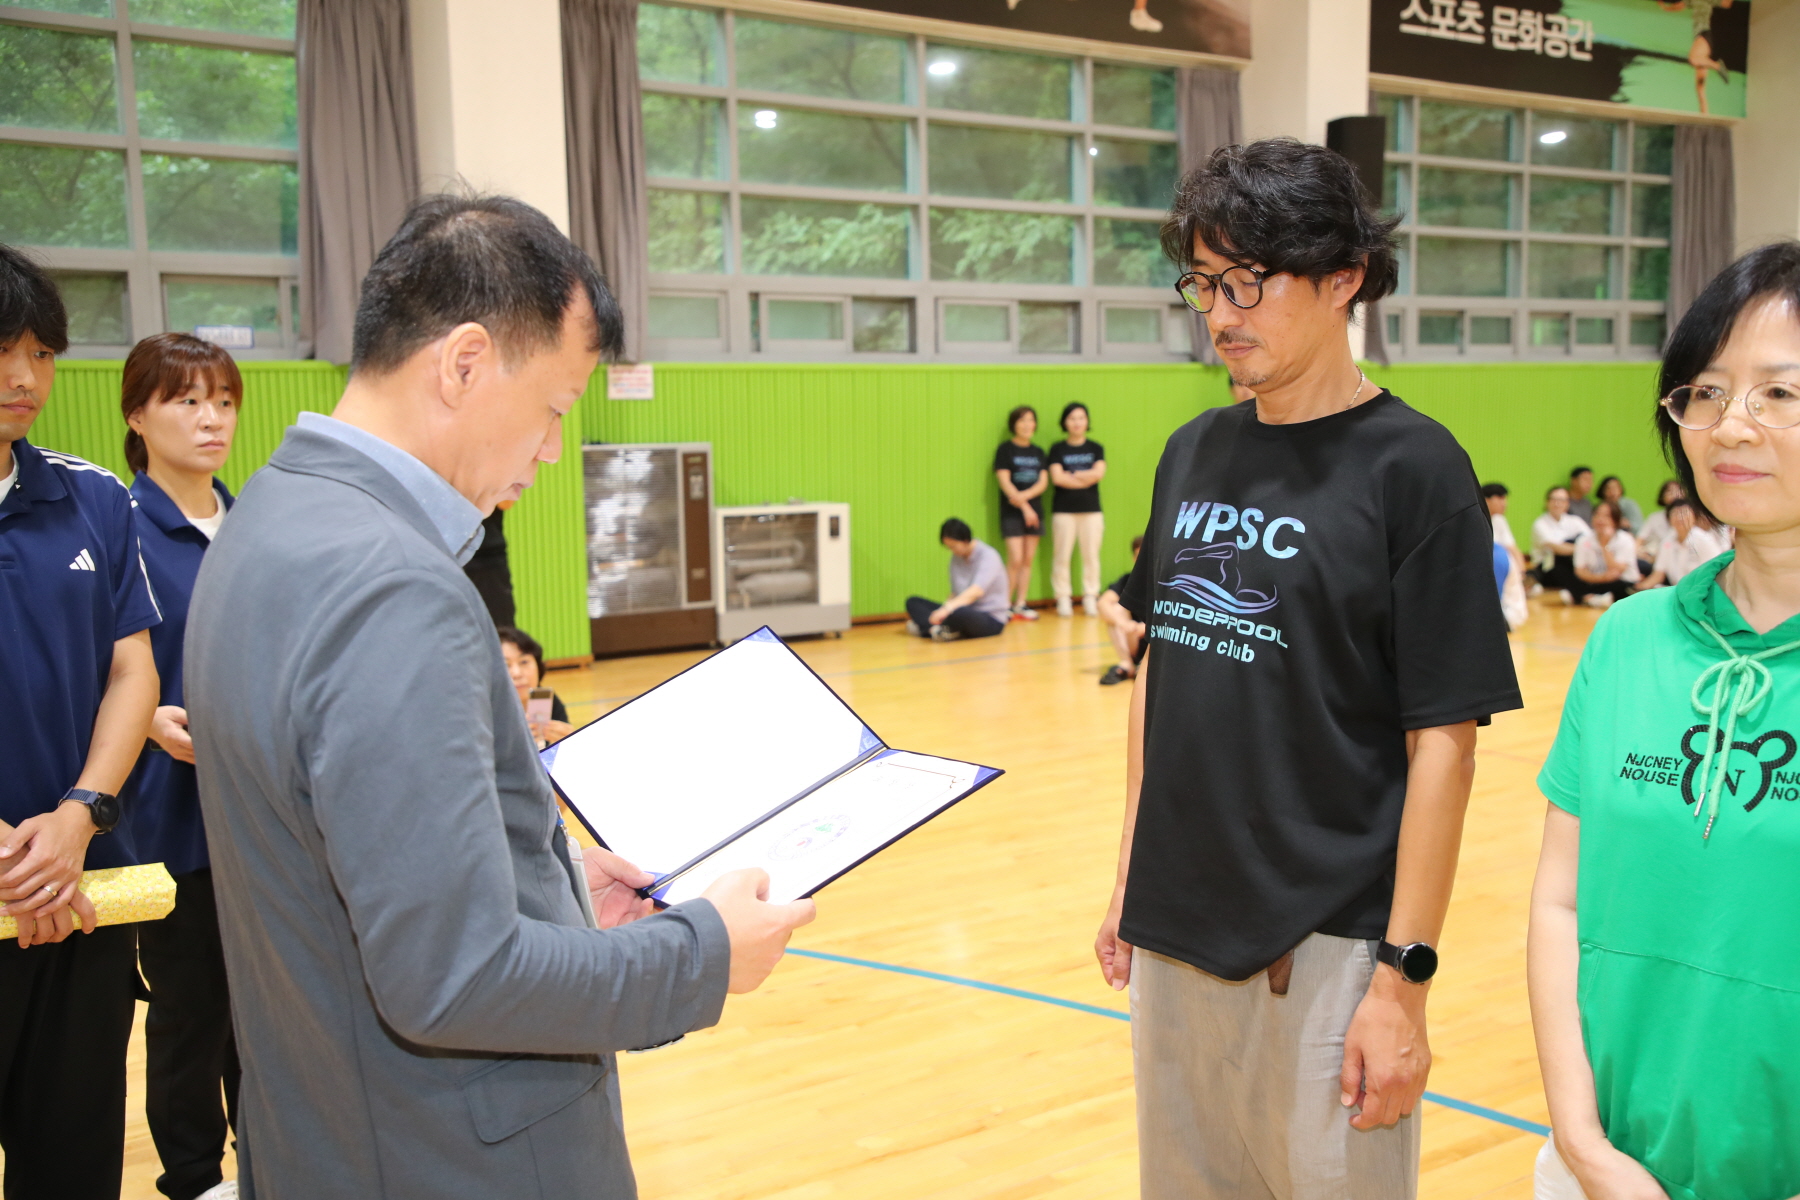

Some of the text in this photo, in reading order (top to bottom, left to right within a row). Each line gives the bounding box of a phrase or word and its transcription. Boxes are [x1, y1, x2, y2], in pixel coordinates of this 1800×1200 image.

[1399, 0, 1595, 62] 스포츠 문화공간
[1173, 501, 1306, 560] WPSC
[1216, 639, 1255, 663] club
[1625, 752, 1684, 771] NJCNEY
[1619, 766, 1680, 787] NOUSE
[1770, 786, 1800, 802] NO
